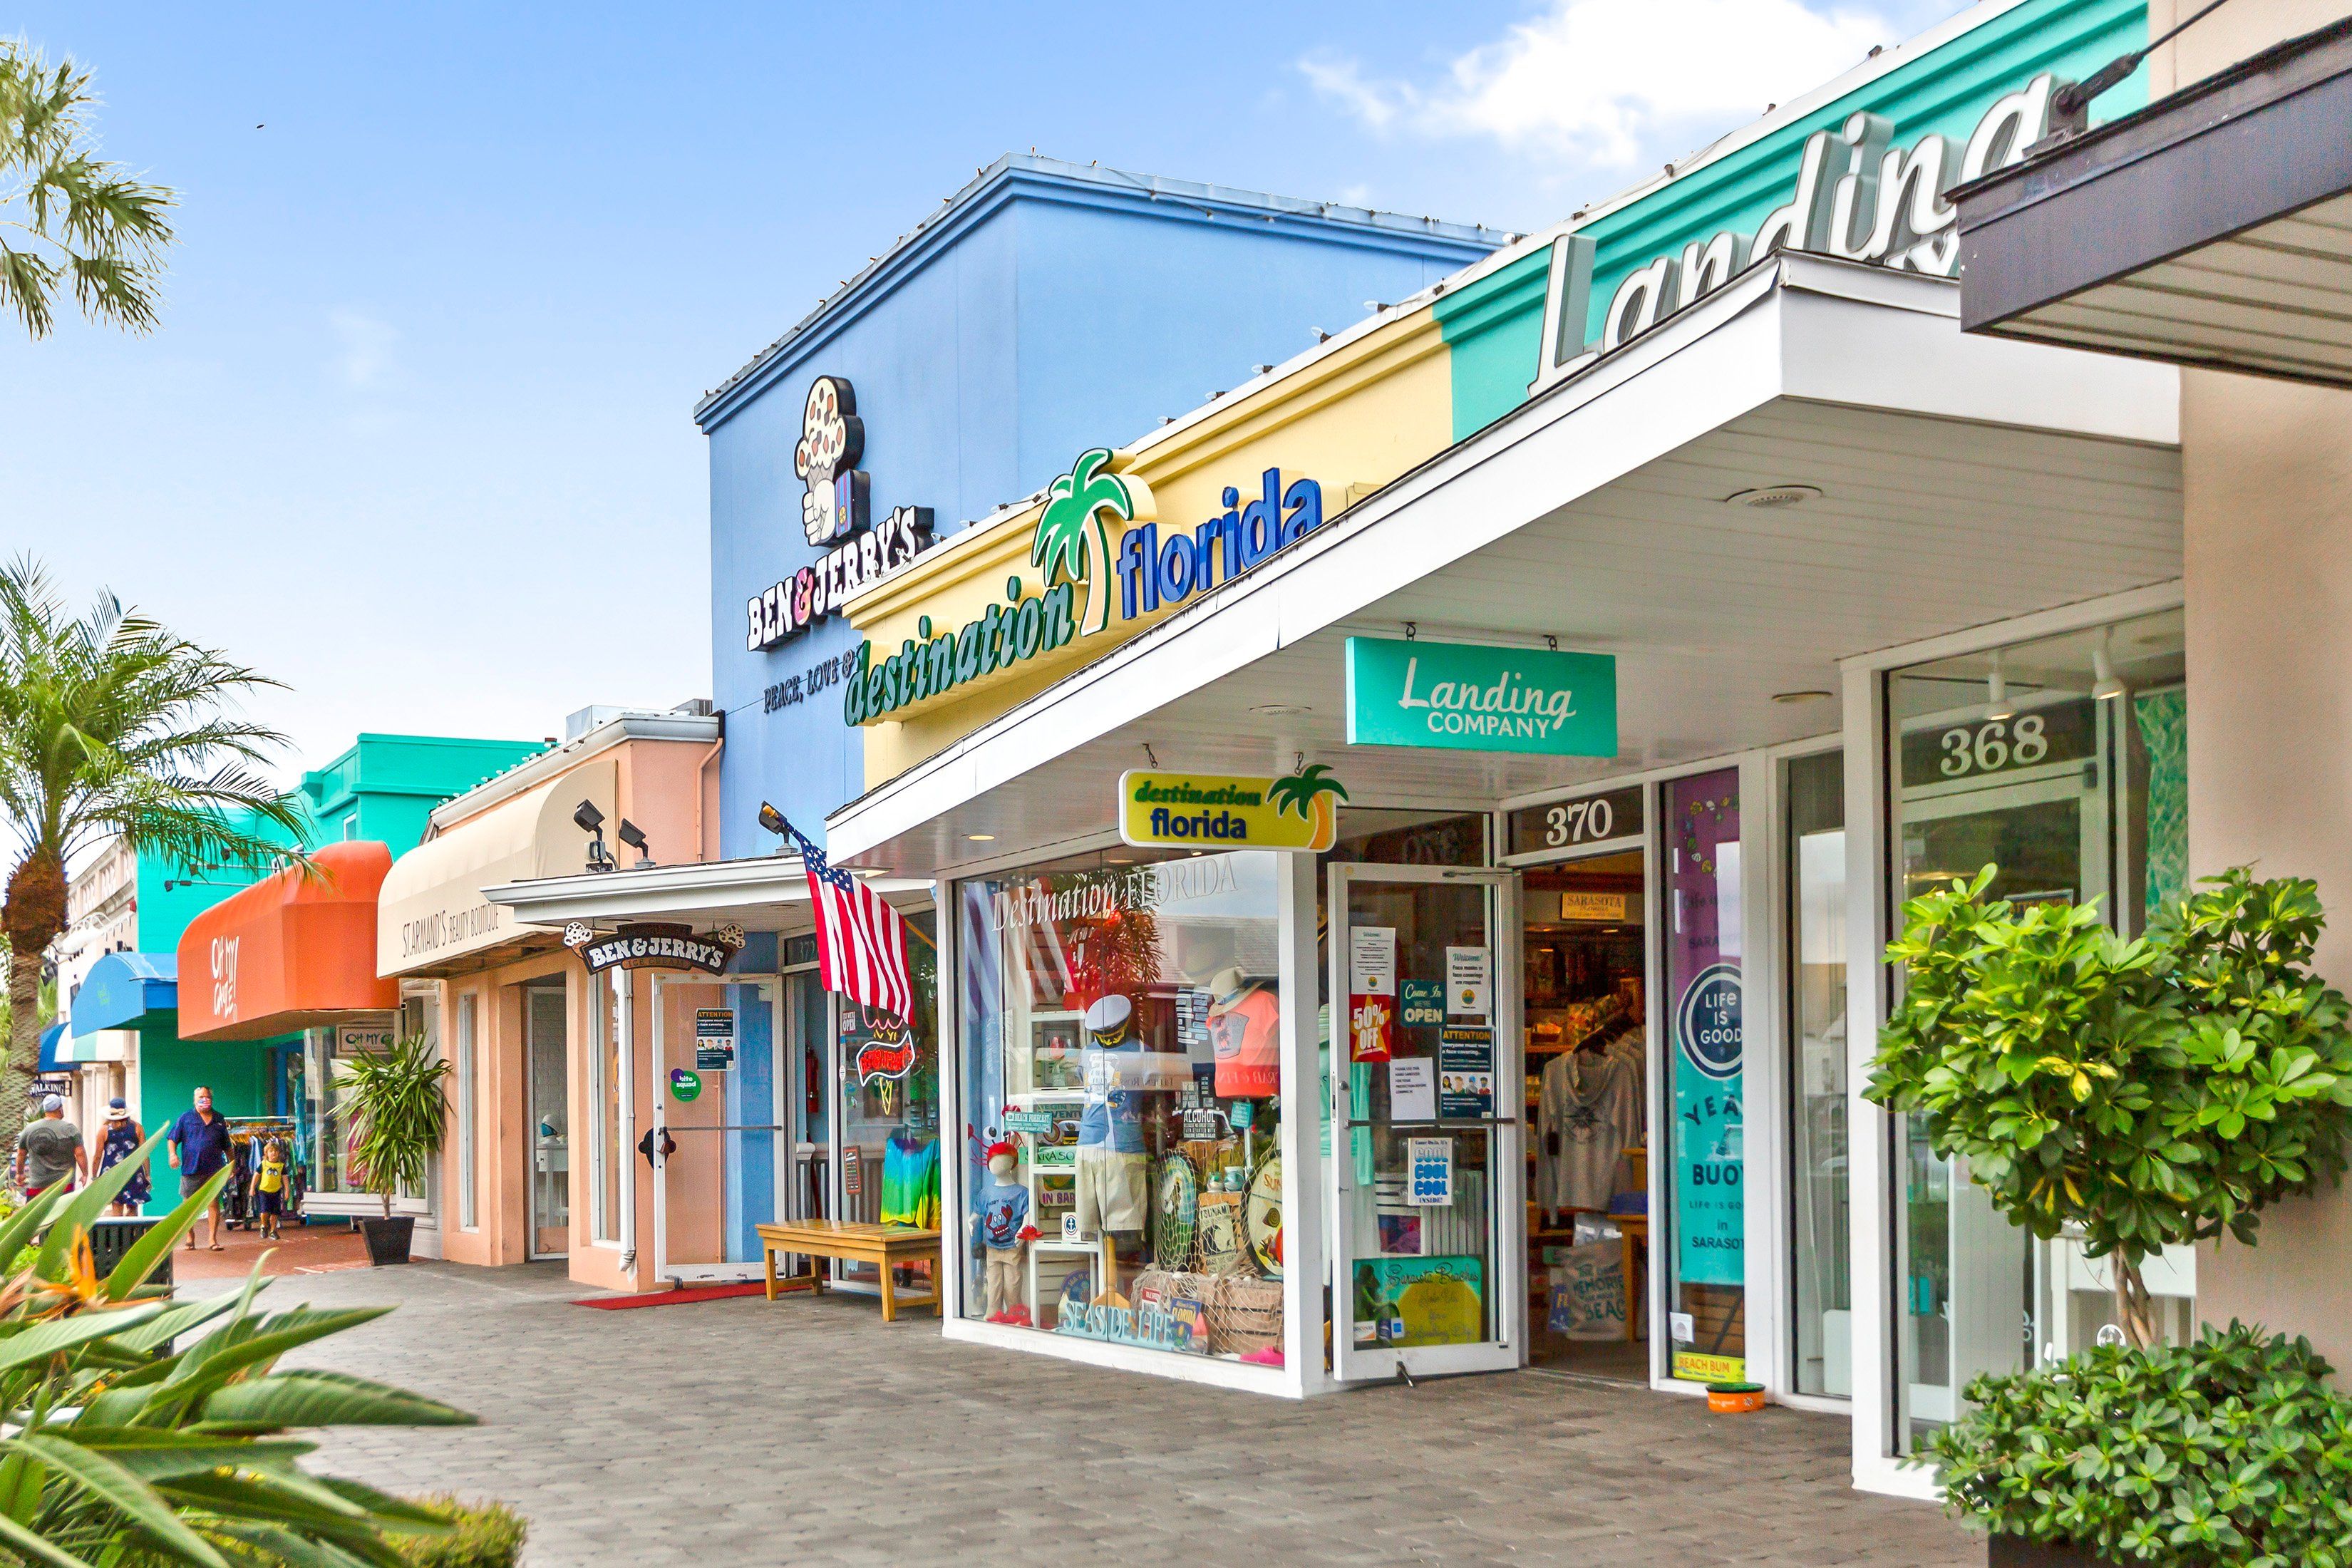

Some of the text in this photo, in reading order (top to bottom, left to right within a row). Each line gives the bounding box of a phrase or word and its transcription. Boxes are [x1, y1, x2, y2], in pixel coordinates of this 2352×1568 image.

[1116, 467, 1323, 620] florida
[845, 576, 1076, 726] destination
[763, 649, 855, 714] PEACE, LOVE &
[1398, 656, 1577, 730] Landing
[1427, 711, 1549, 738] COMPANY
[1939, 716, 2048, 776] 368
[1134, 780, 1262, 806] destination
[1150, 808, 1247, 839] florida
[1546, 799, 1612, 846] 370
[991, 855, 1239, 932] Destination FLORIDA
[449, 910, 470, 944] BEAUTY
[470, 902, 499, 937] BOUTIQUE
[211, 935, 224, 980] OH
[1405, 984, 1443, 1000] Come In
[842, 1018, 856, 1032] OPEN
[1353, 1003, 1385, 1030] 50%
[1404, 1008, 1443, 1023] OPEN
[1713, 1011, 1728, 1025] IS
[366, 1033, 380, 1045] MY
[1359, 1027, 1378, 1050] OFF
[1443, 1031, 1490, 1040] ATTENTION
[1700, 1028, 1742, 1044] GOOD
[1183, 1109, 1216, 1123] ALCOHOL
[1414, 1147, 1448, 1162] COOL
[1414, 1164, 1448, 1179] COOL
[1693, 1163, 1743, 1186] BUO
[1041, 1192, 1076, 1205] IN SAR
[1414, 1180, 1448, 1196] COOL
[1715, 1201, 1724, 1209] IS
[1728, 1201, 1743, 1210] GO
[1717, 1219, 1728, 1230] in
[1691, 1235, 1743, 1250] SARASOT
[1584, 1298, 1626, 1321] BEAC
[1063, 1301, 1175, 1344] SEASIDE LIFE
[1678, 1356, 1731, 1373] BEACH BUM
